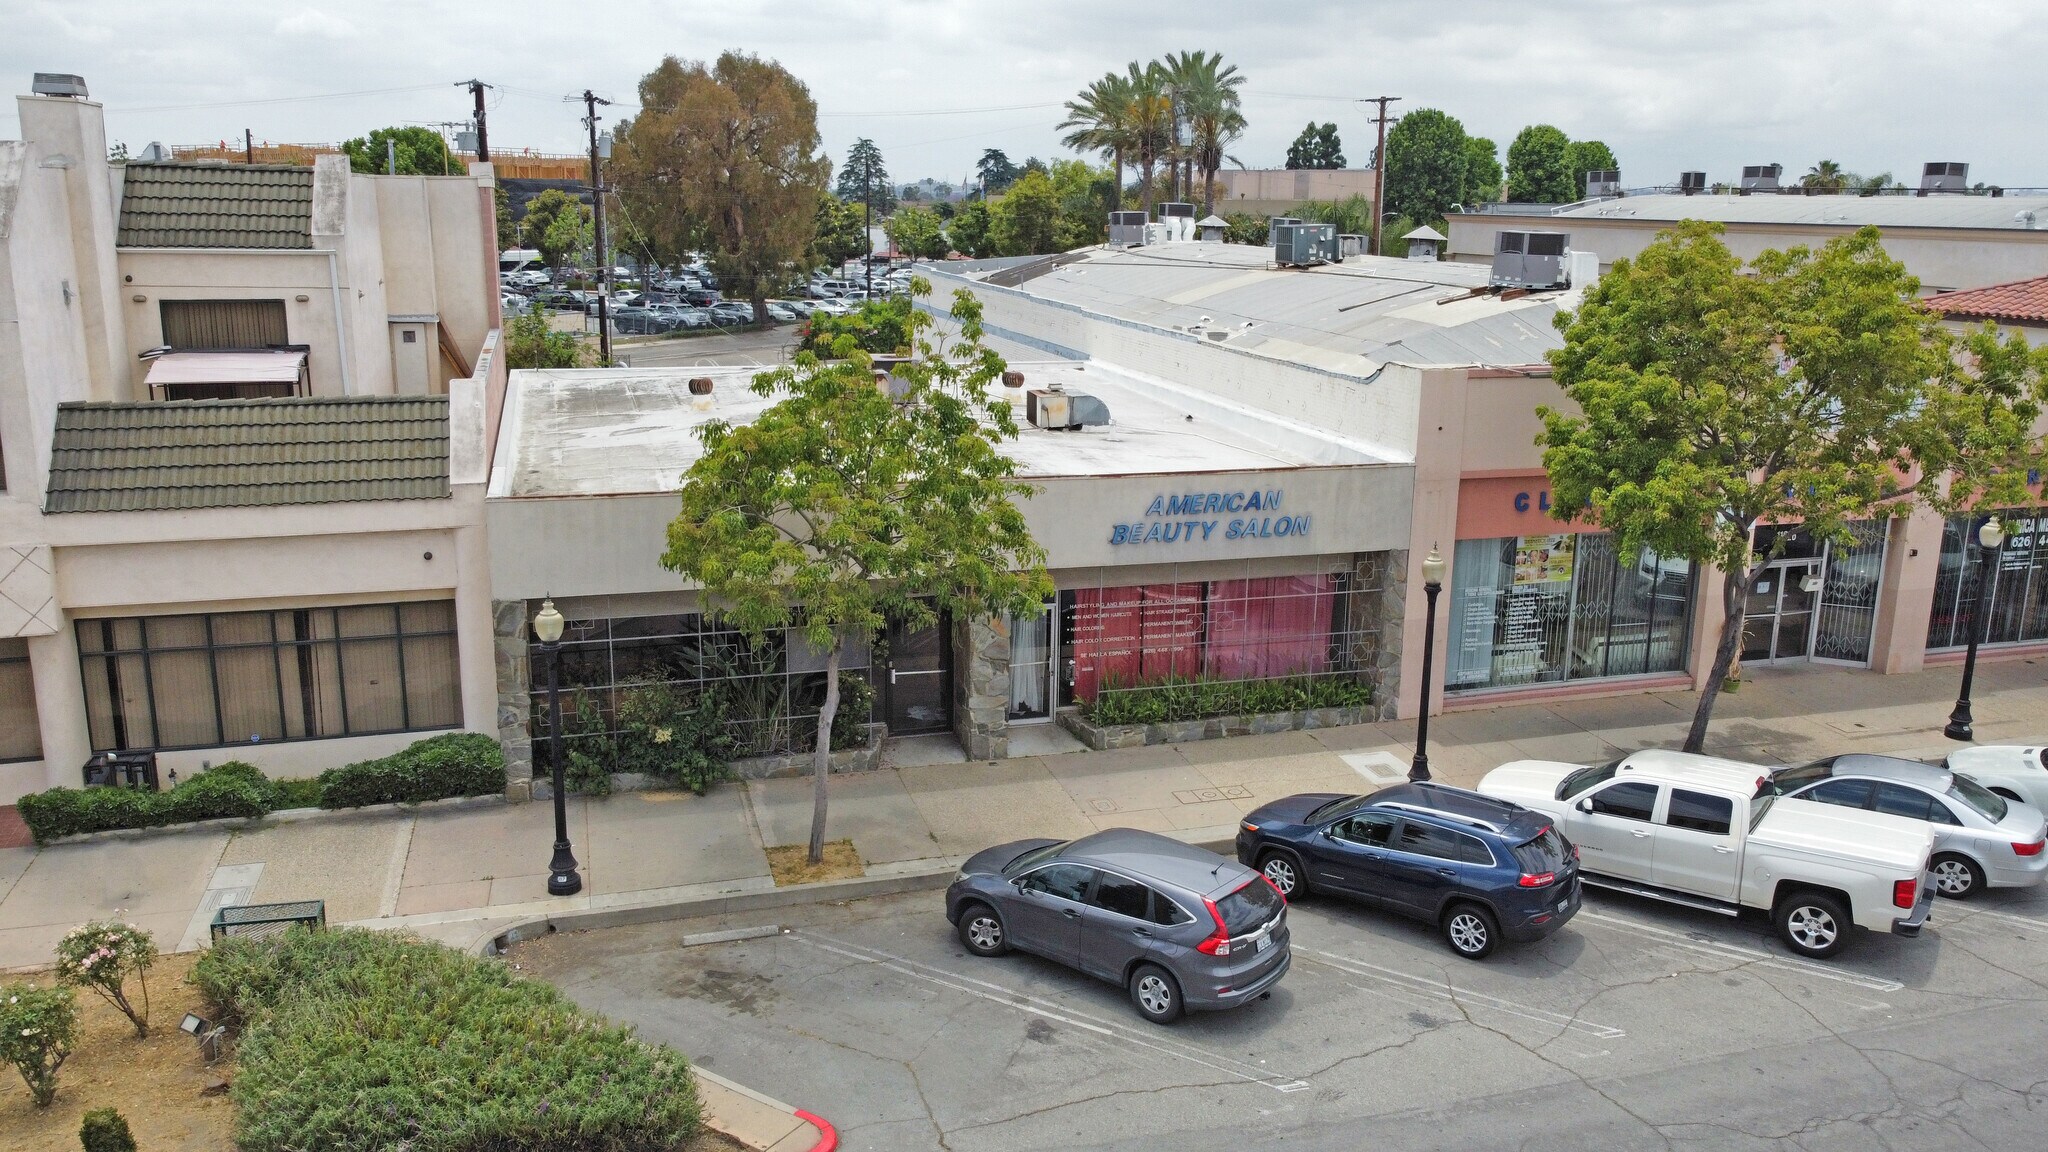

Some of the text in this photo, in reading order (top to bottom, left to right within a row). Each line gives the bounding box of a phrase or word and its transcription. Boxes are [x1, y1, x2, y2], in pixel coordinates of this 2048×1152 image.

[1146, 490, 1282, 516] AMERICAN
[1109, 515, 1312, 545] BEAUTY SALON
[2010, 535, 2033, 549] (626)
[1119, 600, 1141, 608] MAKEUP
